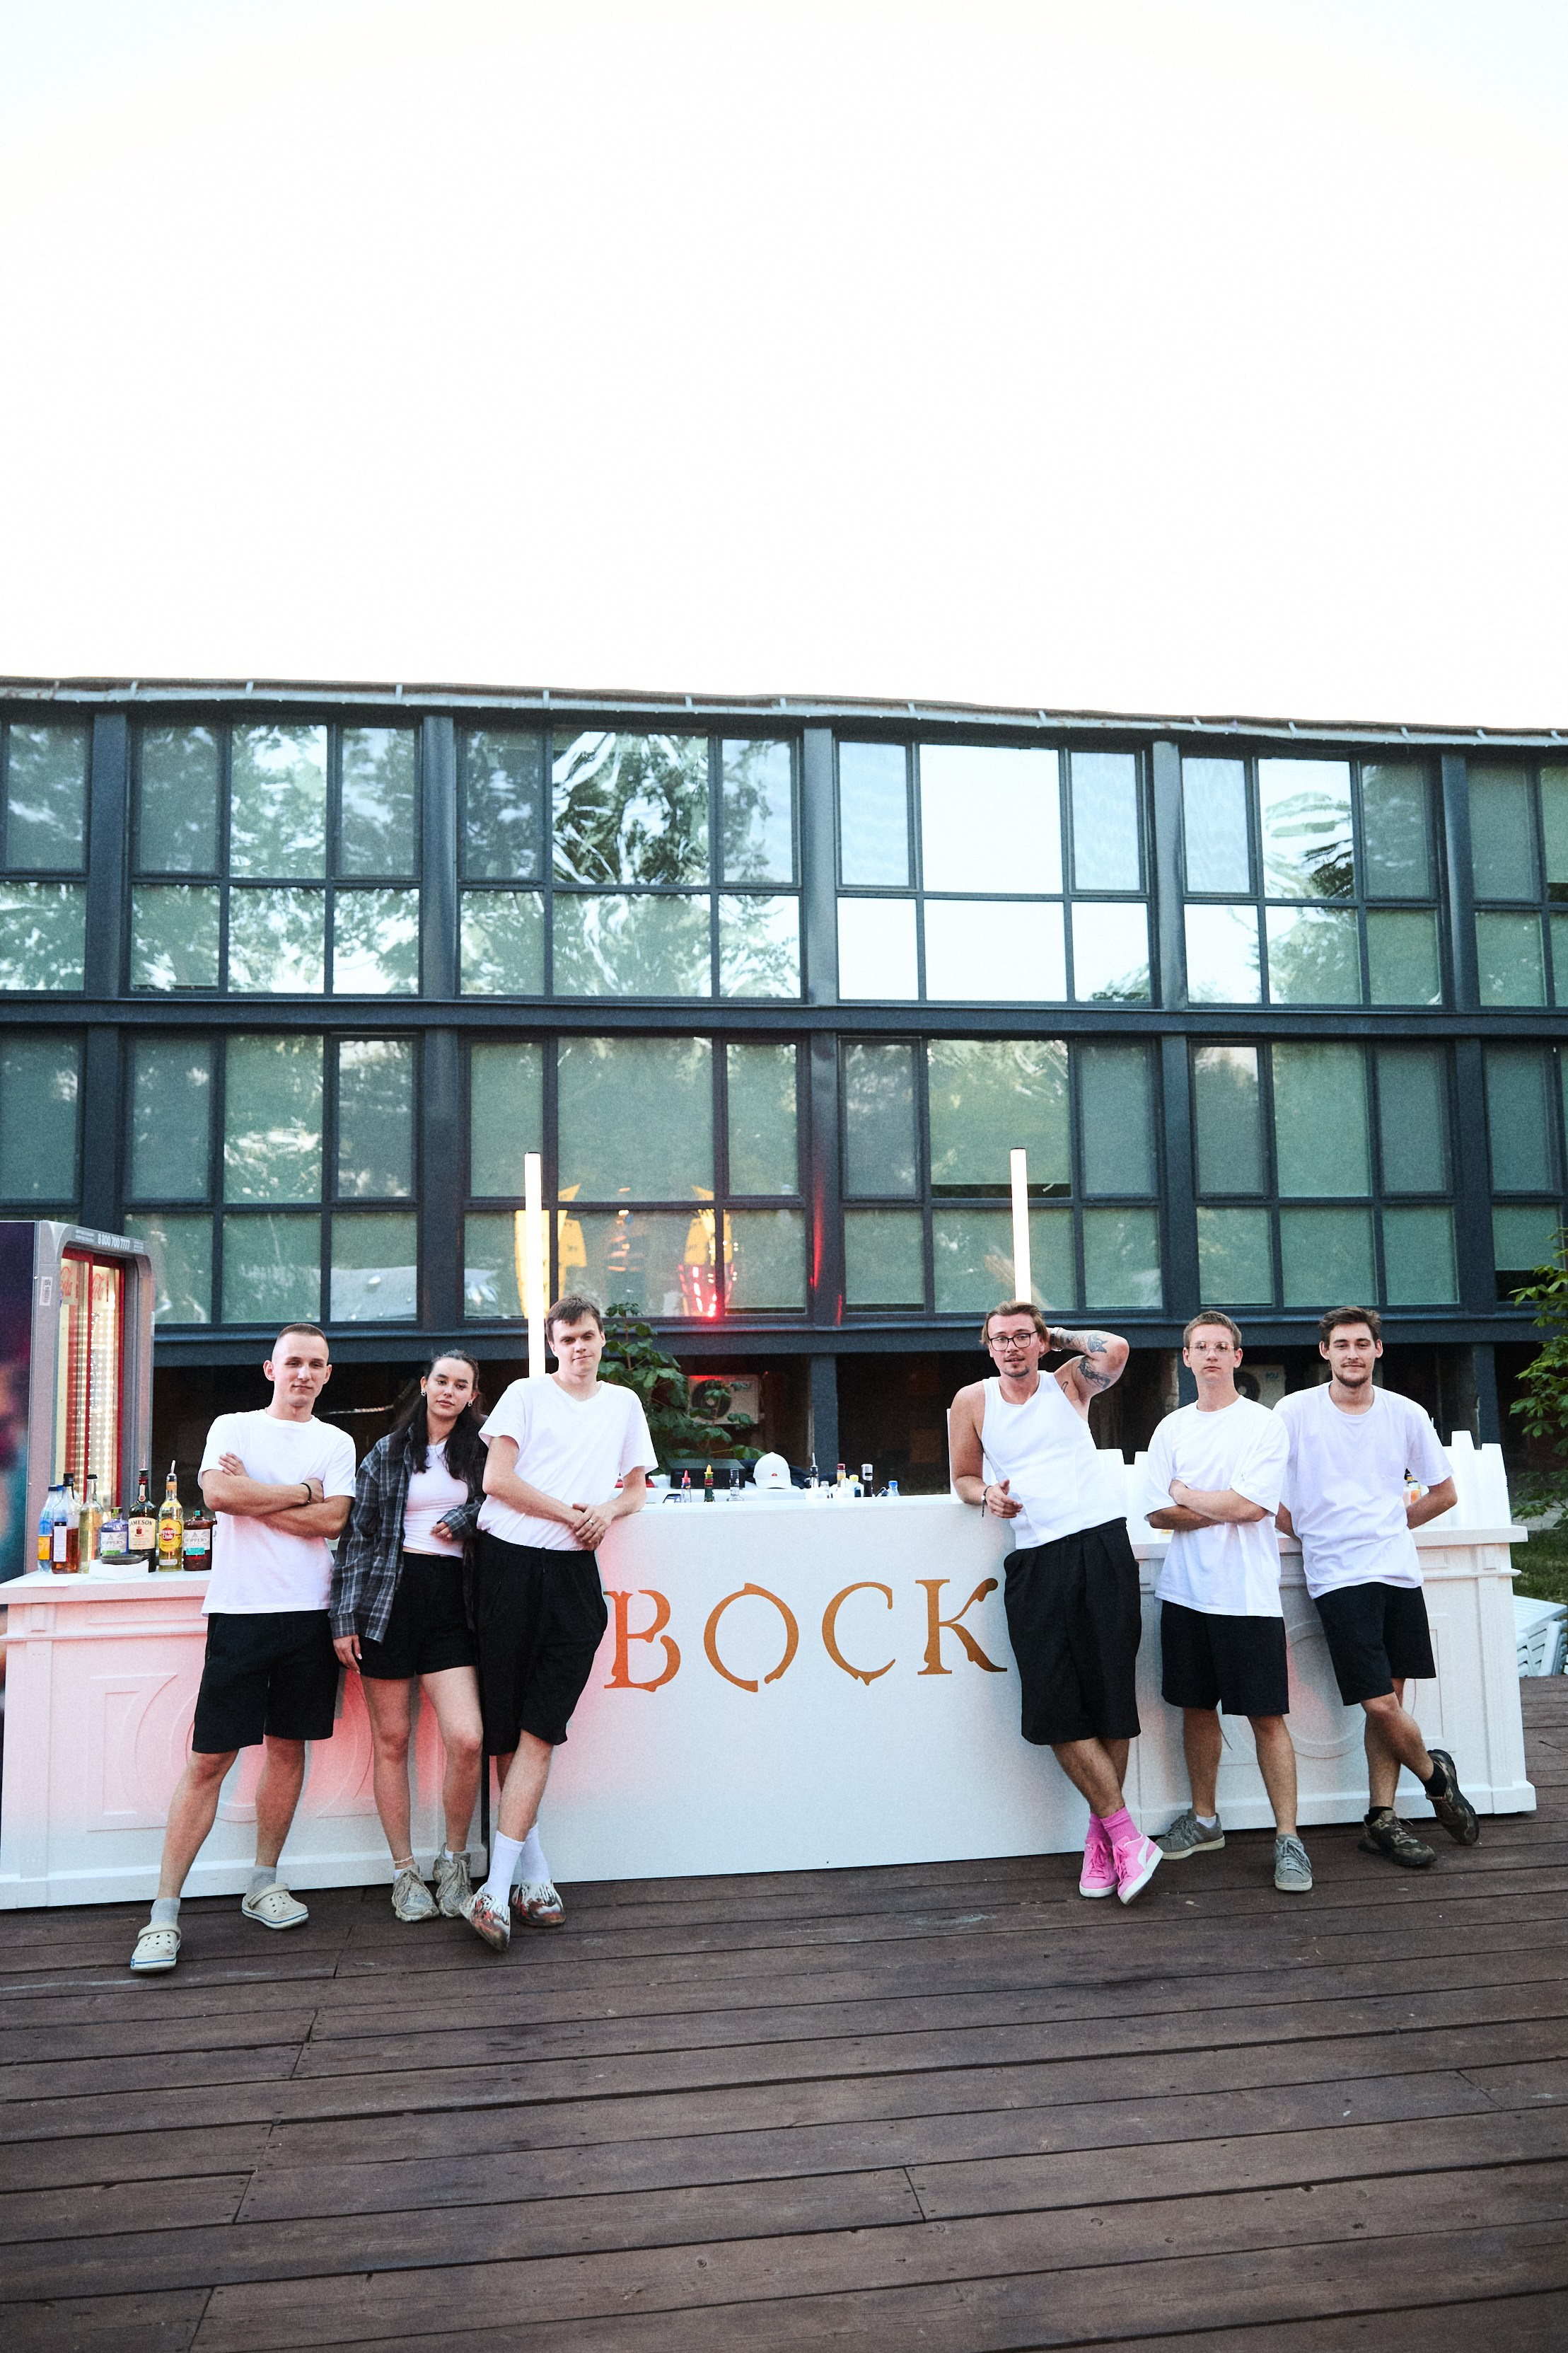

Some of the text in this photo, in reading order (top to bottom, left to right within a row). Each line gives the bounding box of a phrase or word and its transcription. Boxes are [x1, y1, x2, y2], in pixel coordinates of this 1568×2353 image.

[98, 1233, 101, 1245] 8
[101, 1234, 111, 1247] 800
[111, 1236, 120, 1248] 700
[603, 1578, 1008, 1693] BOCK
